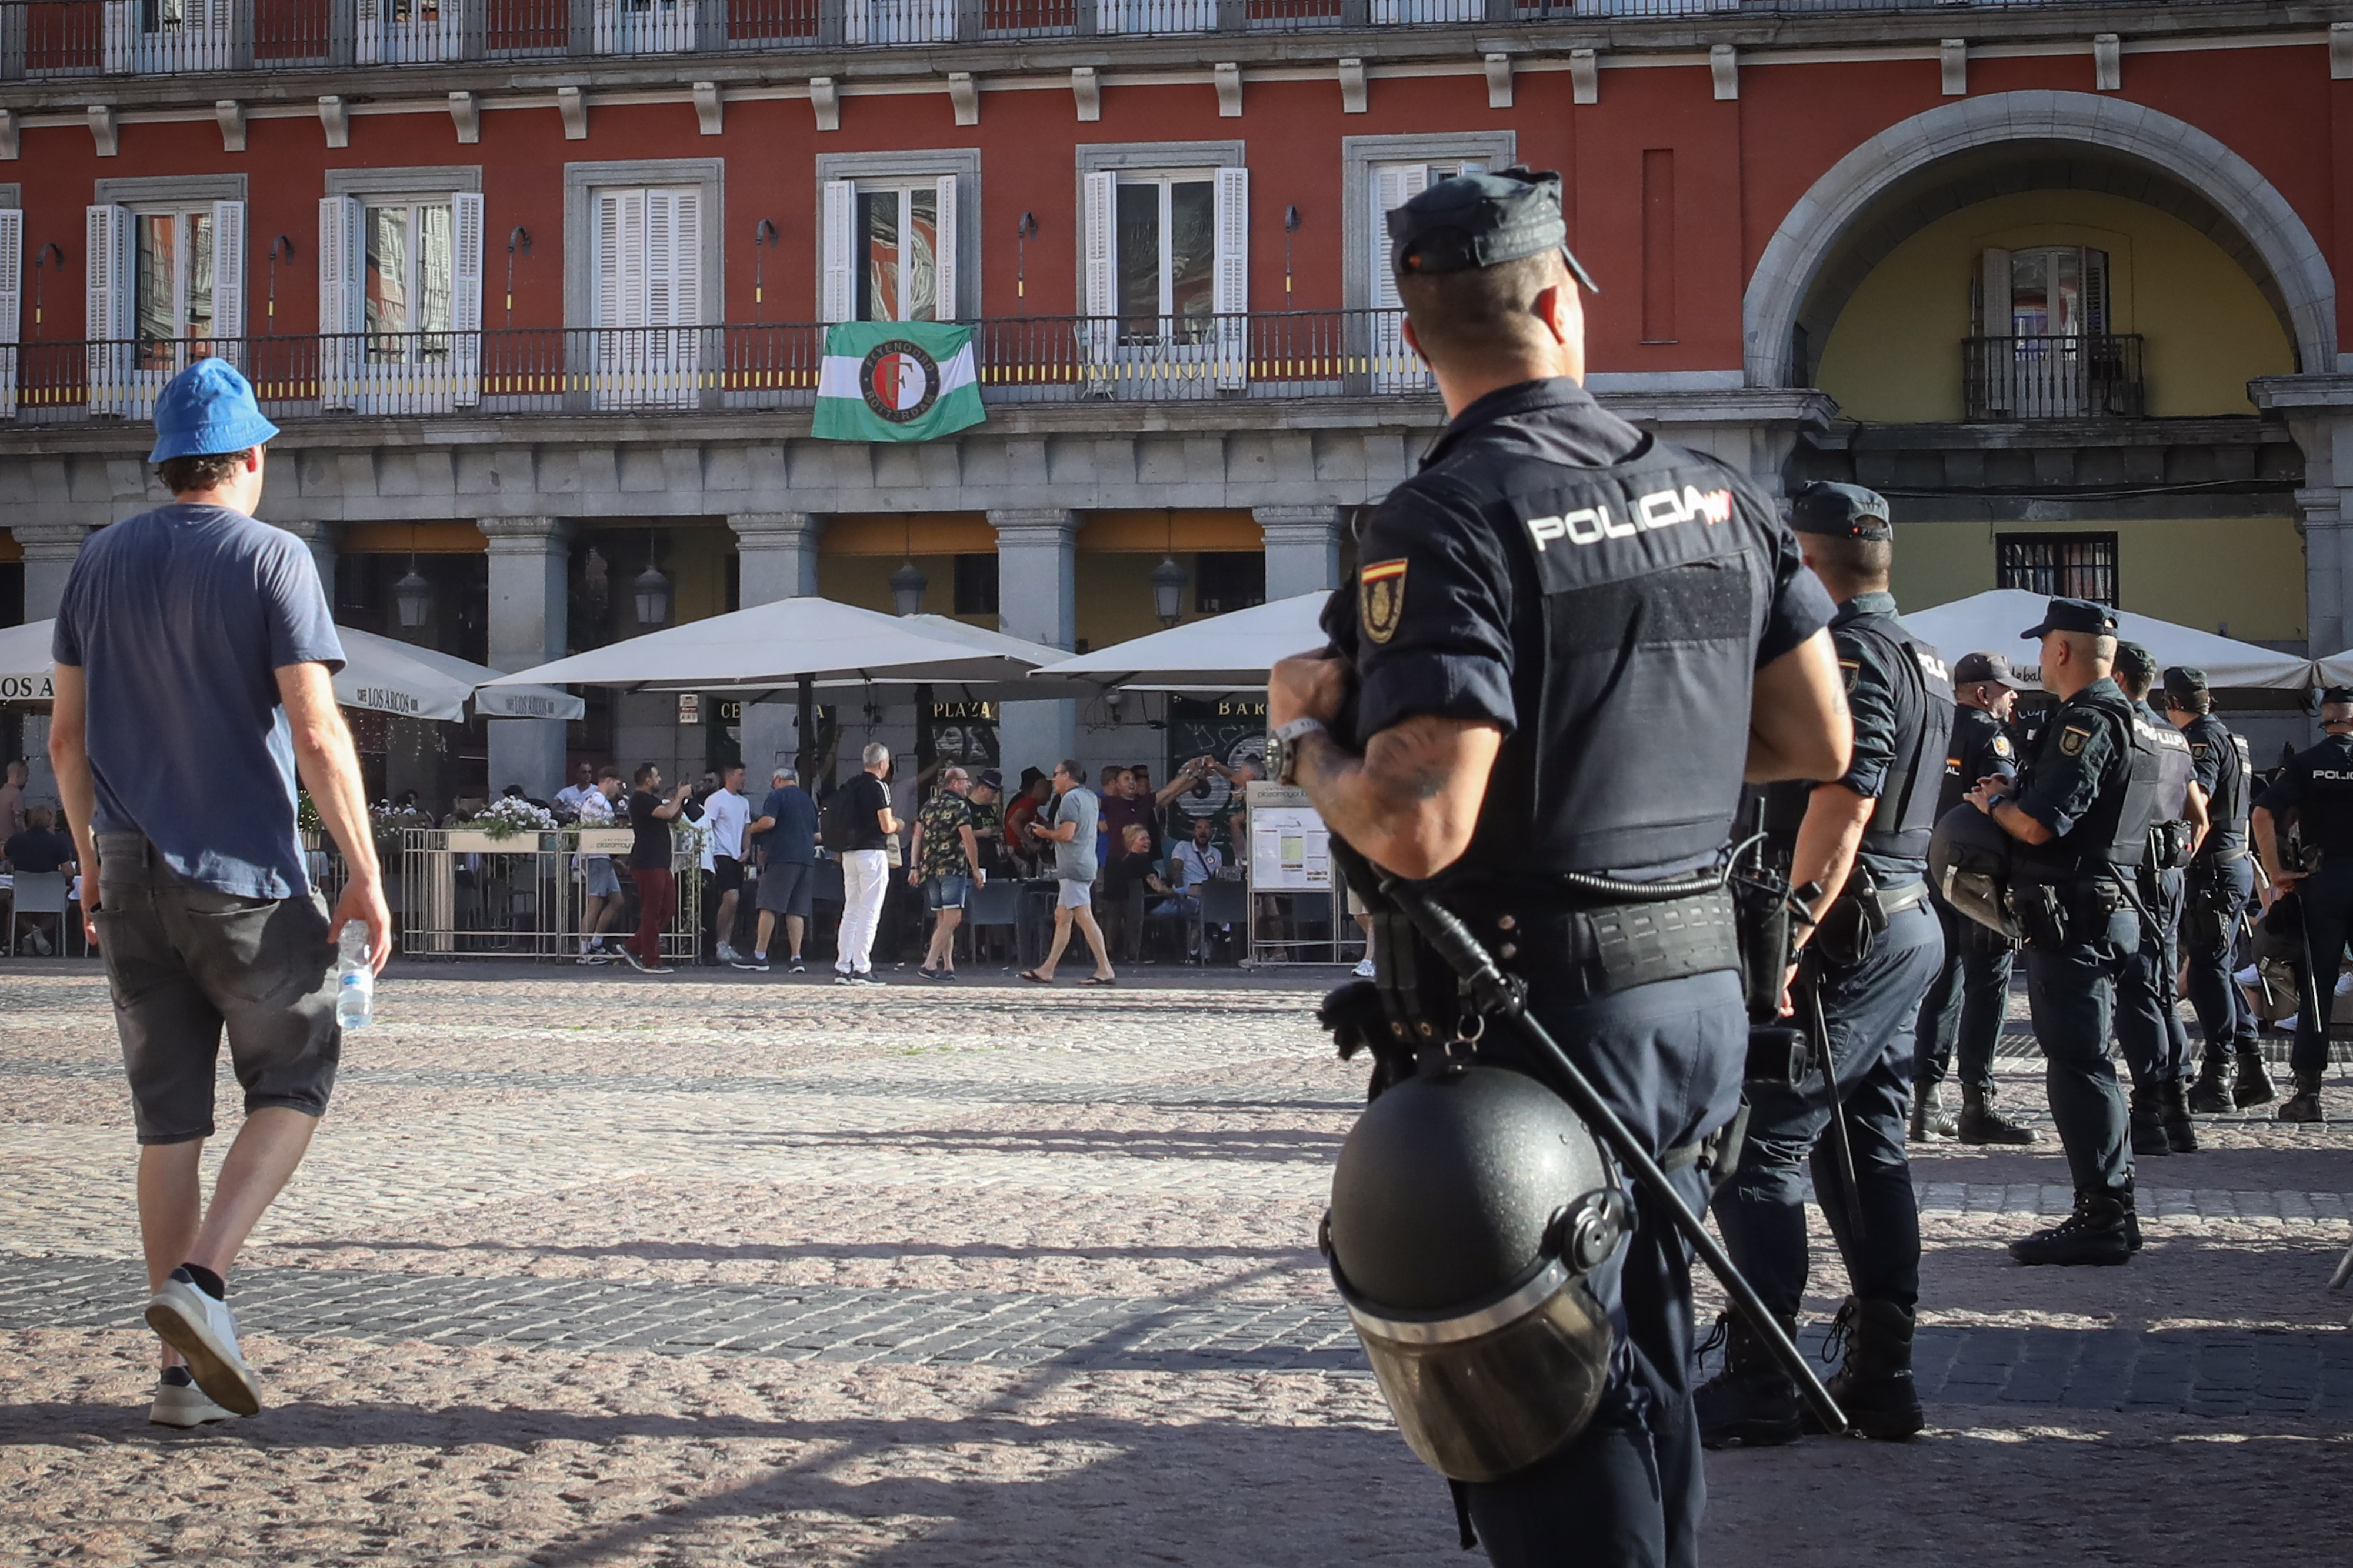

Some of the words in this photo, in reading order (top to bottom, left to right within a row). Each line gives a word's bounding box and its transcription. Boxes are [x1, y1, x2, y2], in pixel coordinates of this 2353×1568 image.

[866, 342, 934, 371] FEYENOORD
[884, 361, 914, 401] F
[865, 391, 935, 421] ROTTERDAM
[0, 677, 32, 697] OS
[368, 688, 384, 708] LOS
[385, 690, 409, 713] ARCOS
